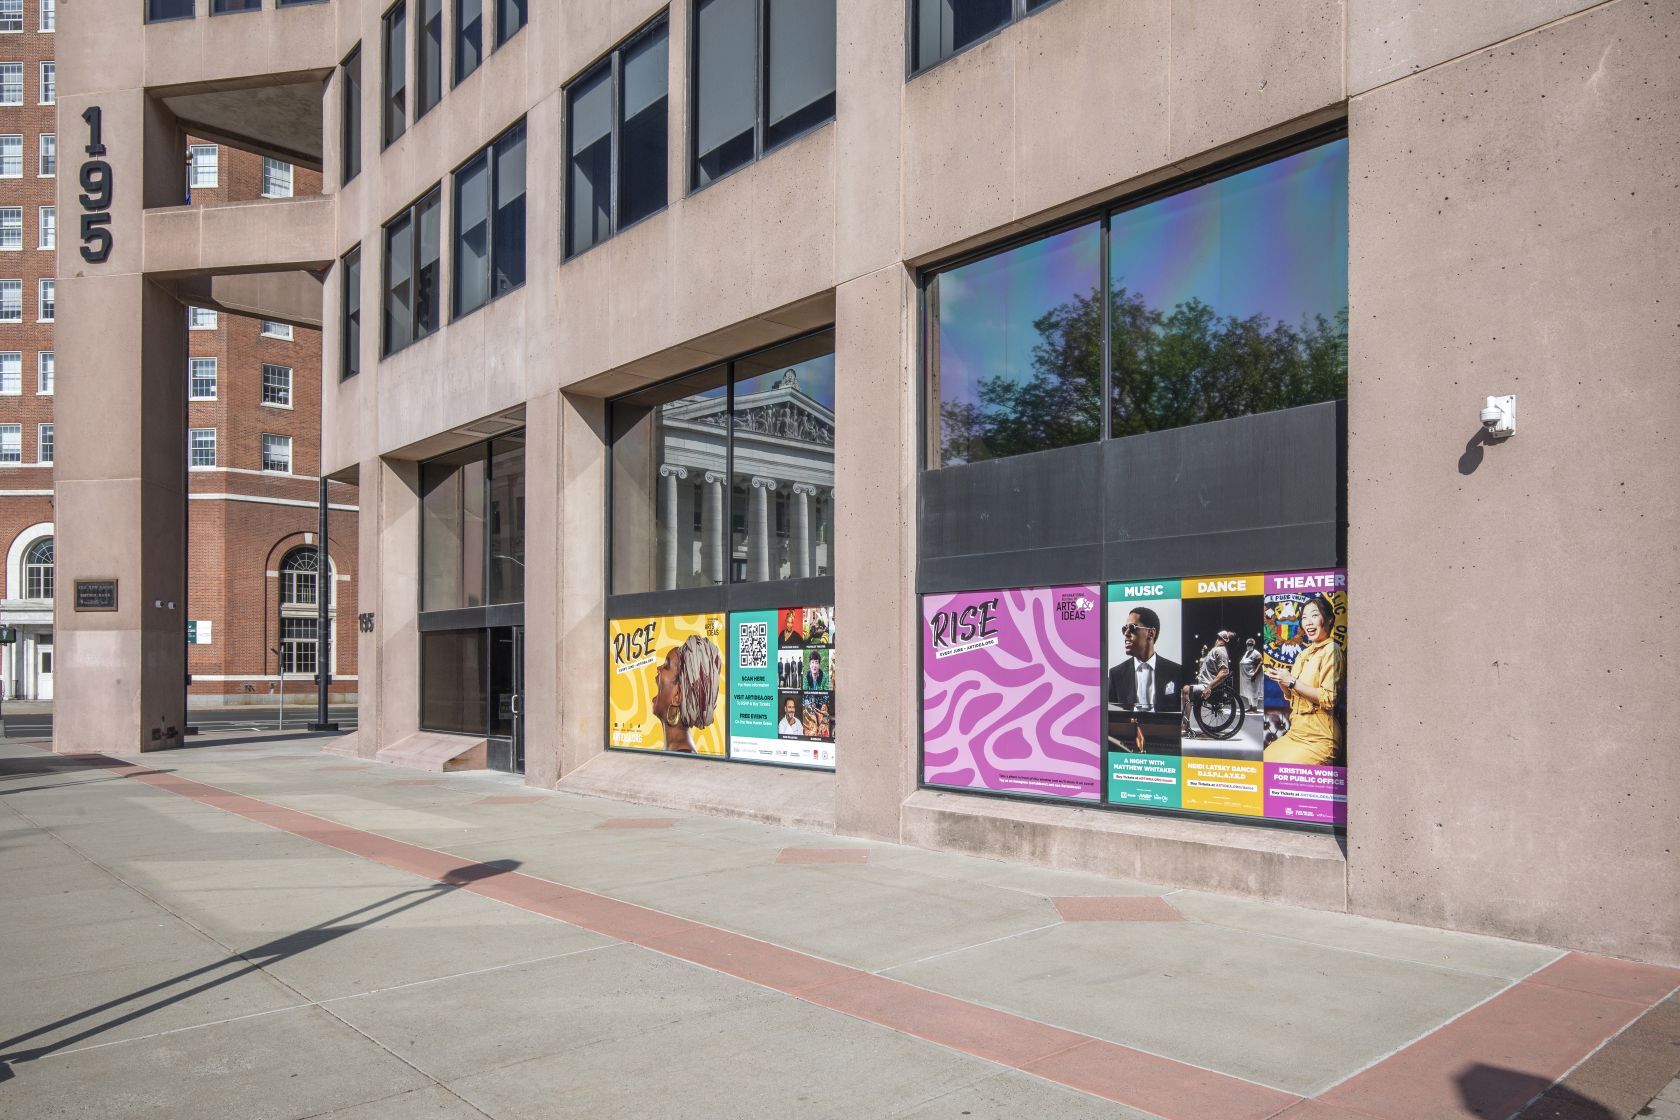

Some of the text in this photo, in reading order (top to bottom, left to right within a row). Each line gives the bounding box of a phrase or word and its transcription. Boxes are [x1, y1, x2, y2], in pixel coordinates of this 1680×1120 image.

[79, 105, 113, 264] 195
[1197, 580, 1246, 593] DANCE
[1274, 574, 1345, 590] THEATER
[1125, 585, 1164, 597] MUSIC
[1056, 601, 1077, 611] ARTS
[1061, 610, 1086, 621] IDEAS
[931, 598, 998, 648] RISE
[613, 621, 656, 664] RISE
[1113, 763, 1176, 774] MATTHEW WHITAKER
[1279, 767, 1339, 777] KRISTINA WONG
[1290, 775, 1316, 783] PUBLIC
[1317, 777, 1344, 786] OFFICE
